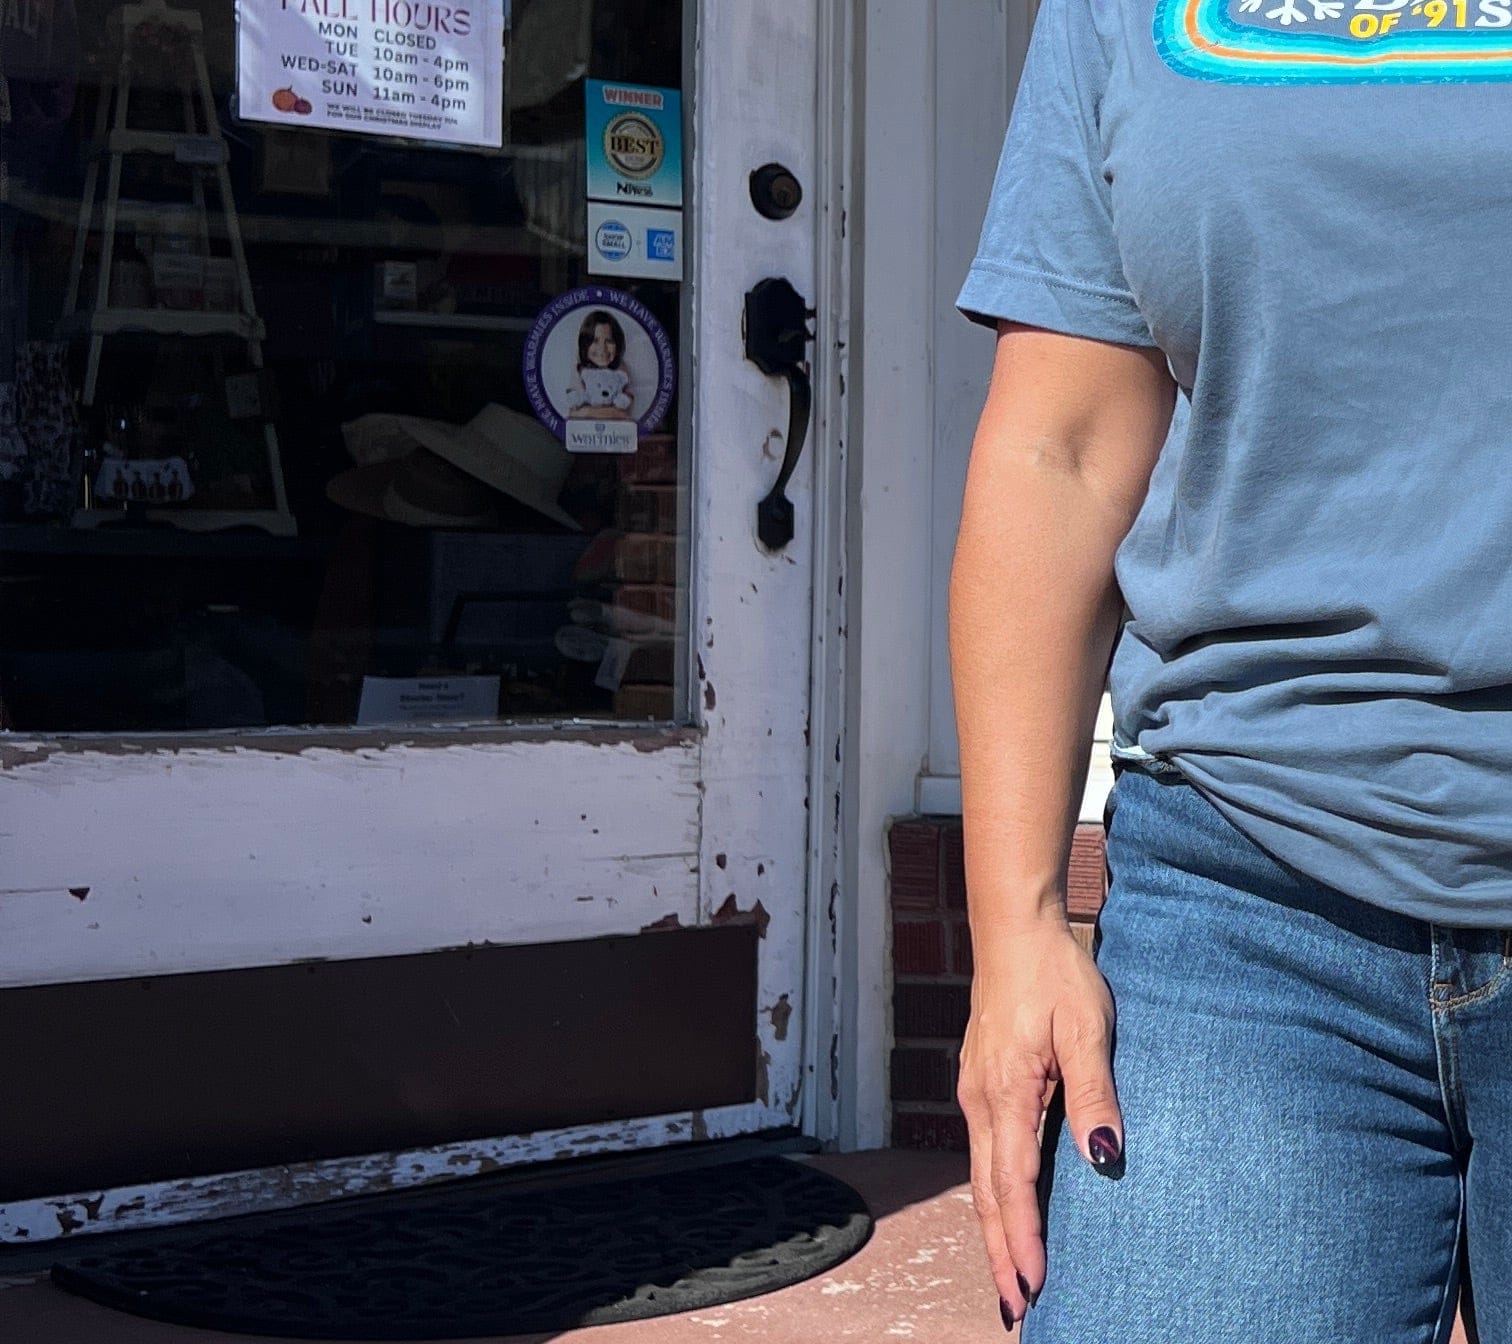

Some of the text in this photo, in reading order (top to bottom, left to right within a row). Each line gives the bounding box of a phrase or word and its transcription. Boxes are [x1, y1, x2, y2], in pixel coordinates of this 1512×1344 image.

[318, 21, 437, 50] MON CLOSED
[1349, 12, 1402, 39] OF
[325, 41, 358, 57] TUE
[373, 47, 418, 66] 10am
[433, 55, 469, 73] 4pm
[281, 55, 359, 77] WED-SAT
[373, 67, 418, 86] 10am
[434, 74, 470, 92] 6pm
[322, 80, 358, 97] SUN
[373, 87, 415, 105] 11am
[431, 93, 466, 112] 4pm
[604, 87, 662, 107] WINNER
[610, 135, 660, 156] BEST
